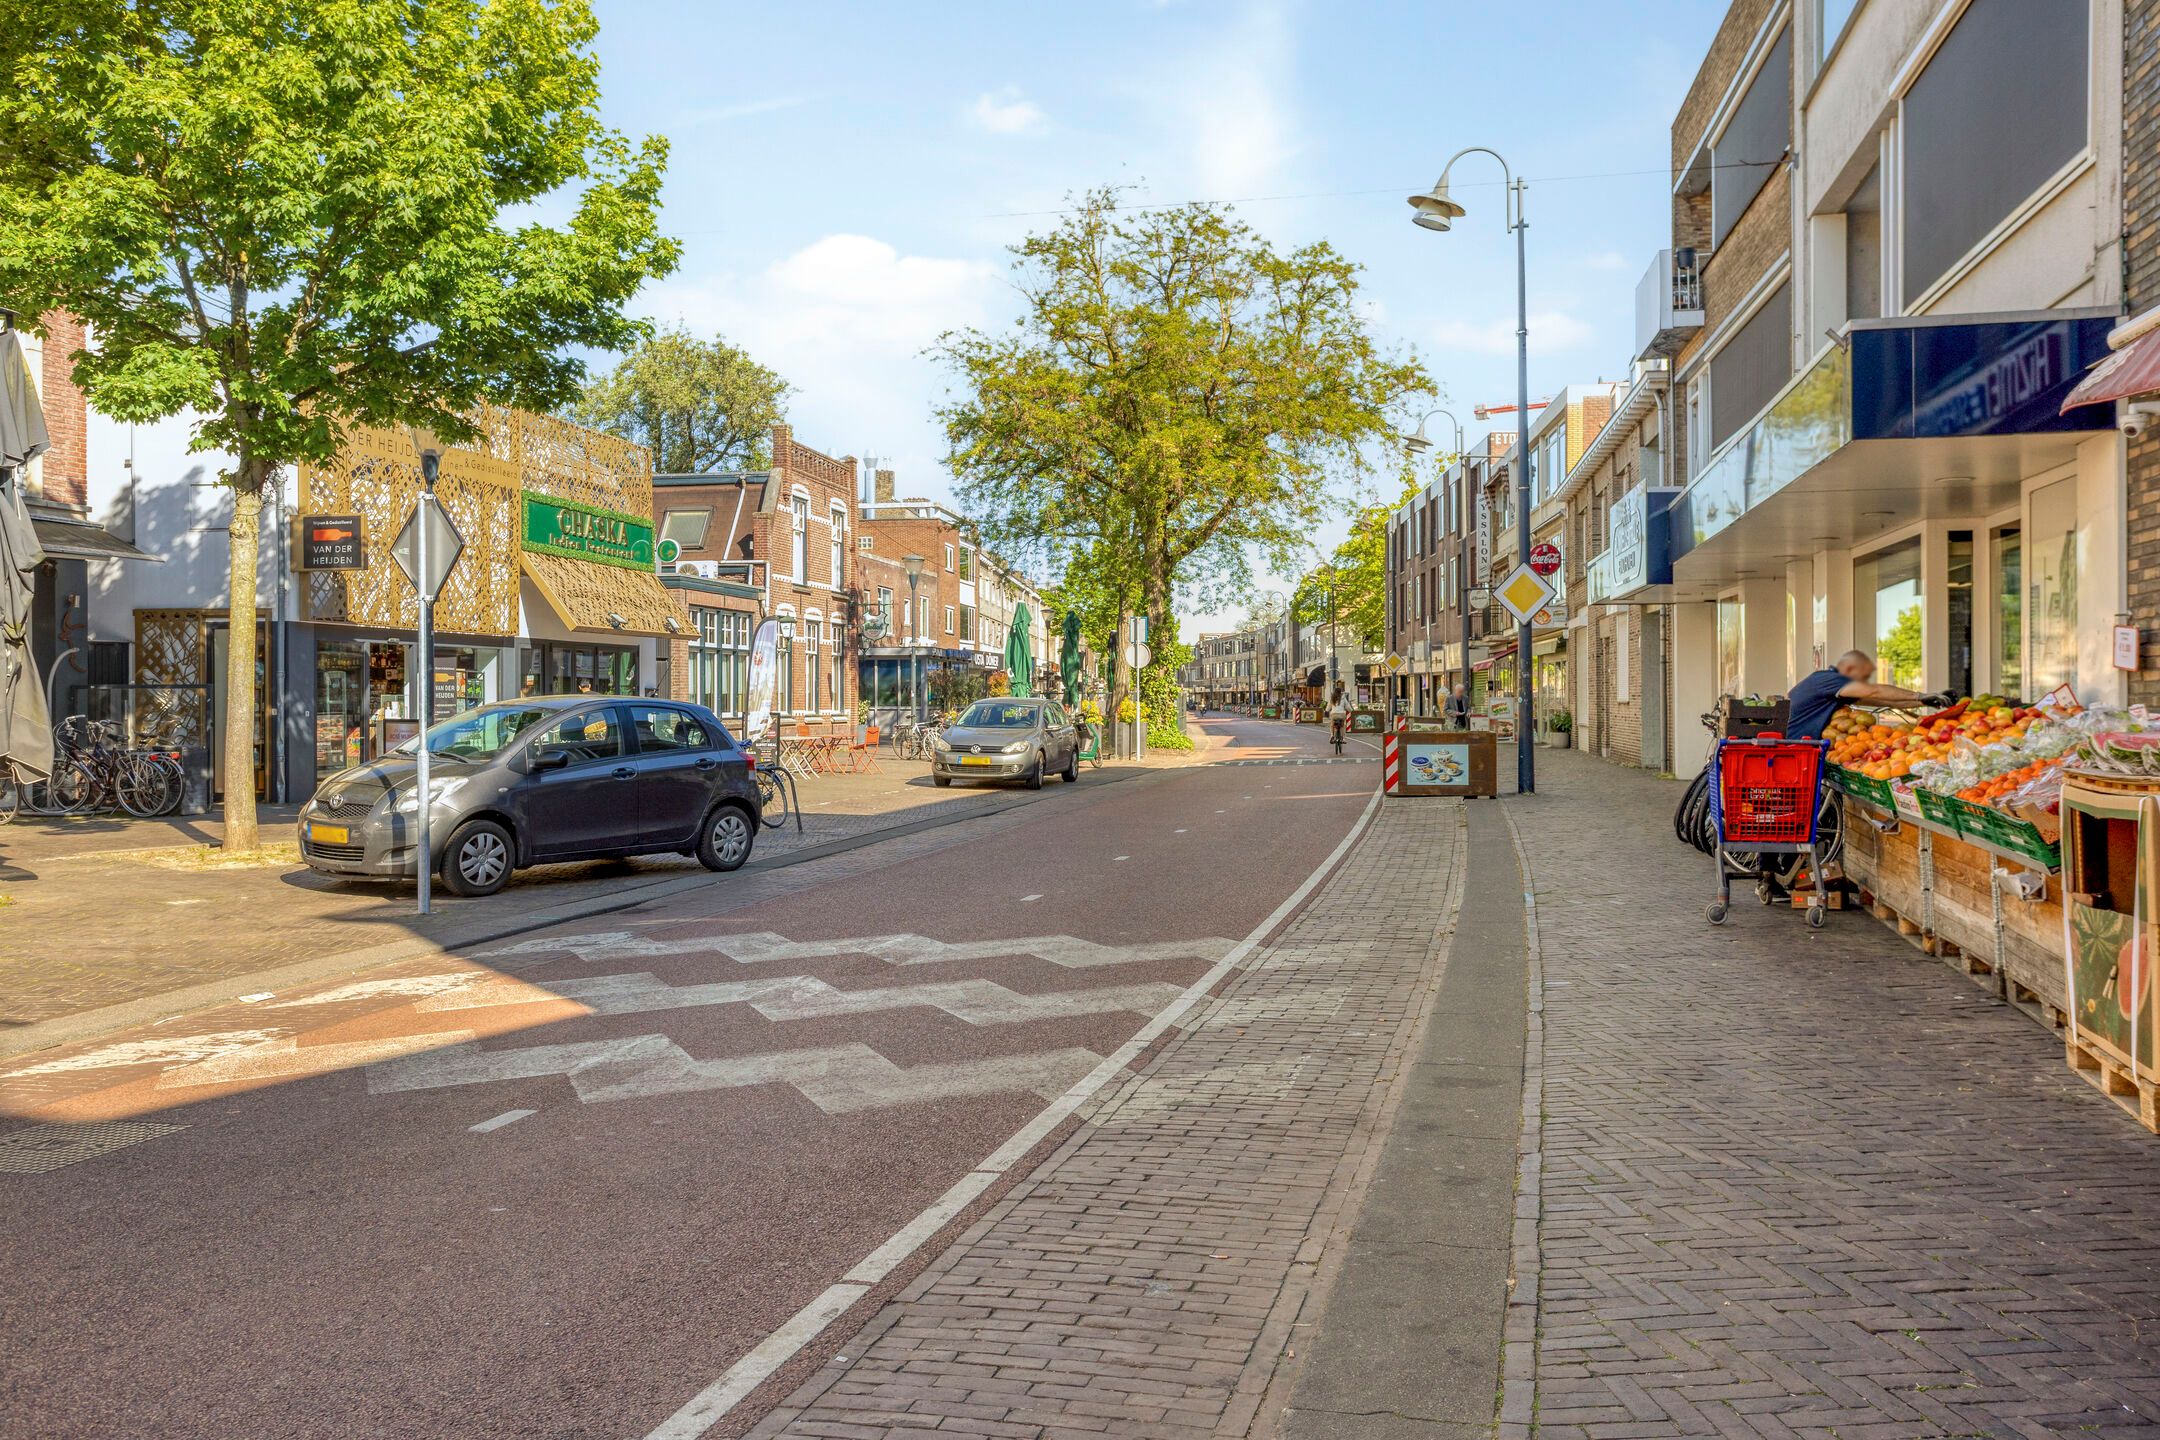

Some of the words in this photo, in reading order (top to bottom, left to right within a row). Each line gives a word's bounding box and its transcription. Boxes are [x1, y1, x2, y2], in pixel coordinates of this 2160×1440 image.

[349, 429, 372, 448] DER
[556, 508, 628, 547] CHASKA
[313, 545, 332, 554] VAN
[334, 544, 353, 553] DER
[549, 532, 581, 549] Indian
[586, 540, 634, 560] Restaurant
[312, 556, 353, 565] HEIJDEN
